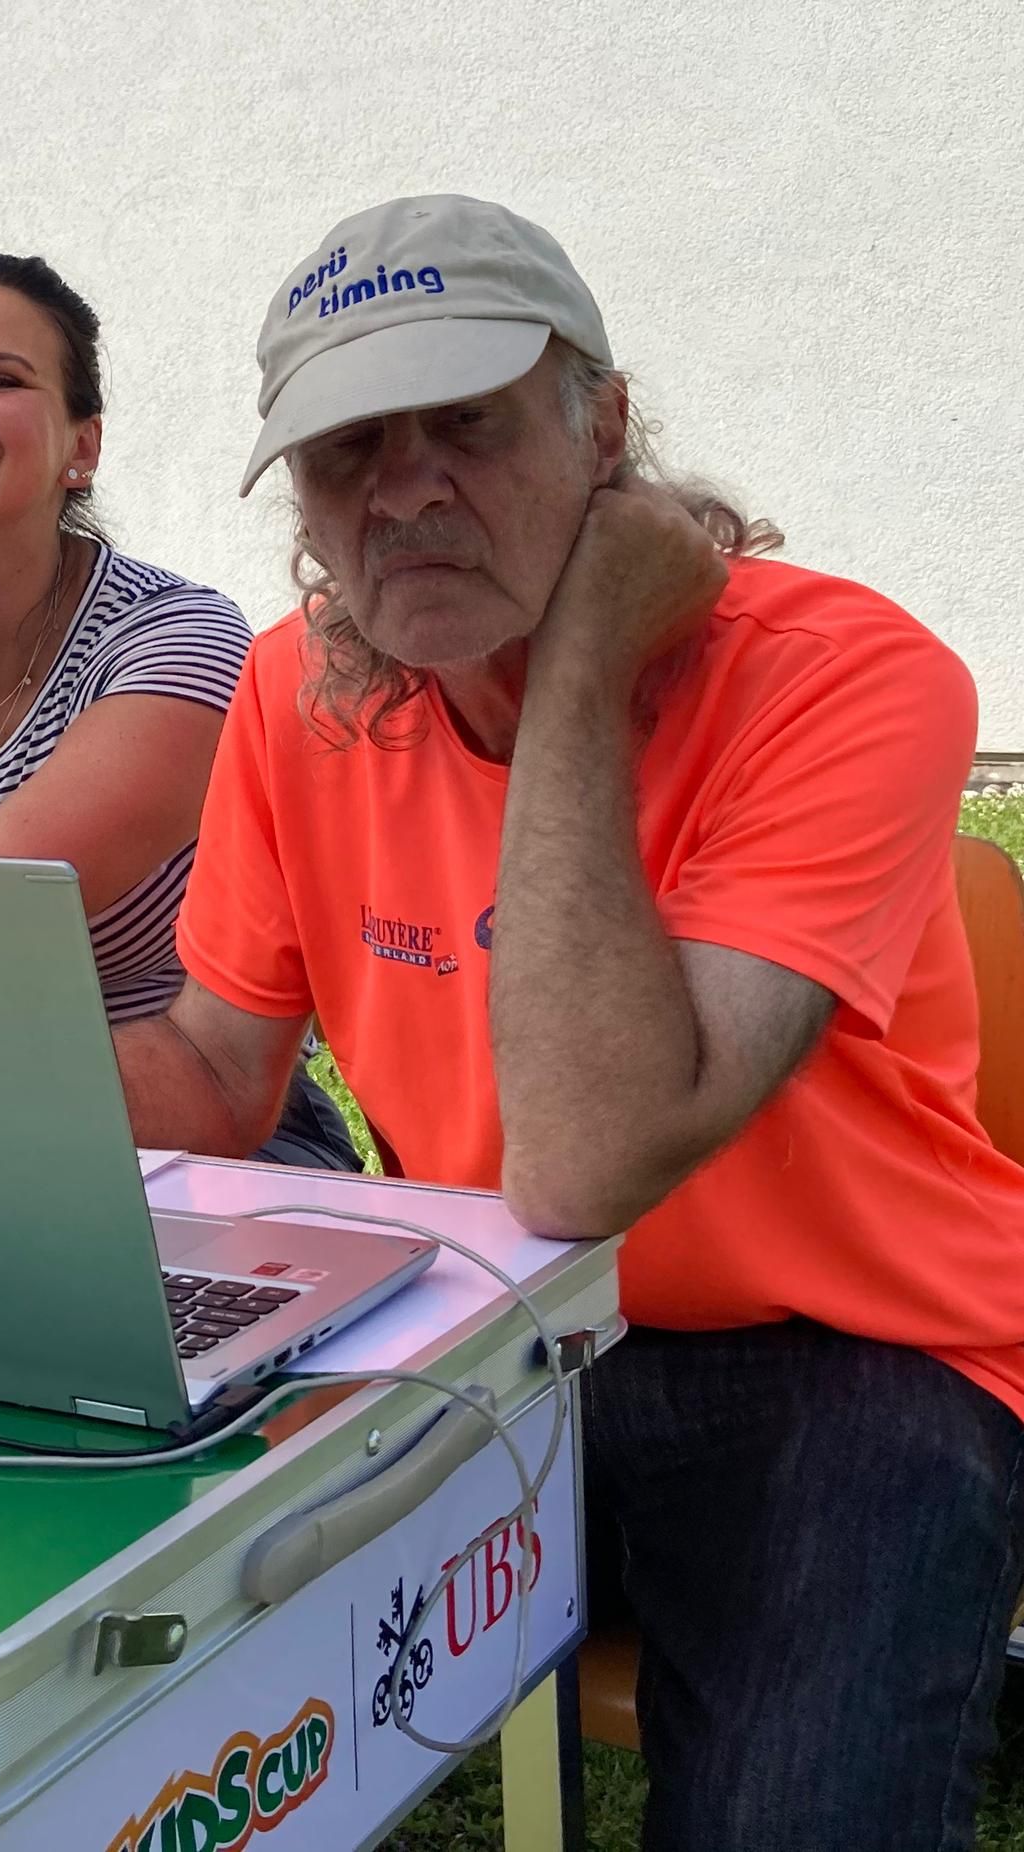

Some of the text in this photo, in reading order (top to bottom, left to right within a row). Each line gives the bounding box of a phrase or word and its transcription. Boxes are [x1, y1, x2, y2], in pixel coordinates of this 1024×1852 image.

[319, 264, 445, 318] timing
[441, 1496, 542, 1657] UBS
[256, 1716, 328, 1813] CUP
